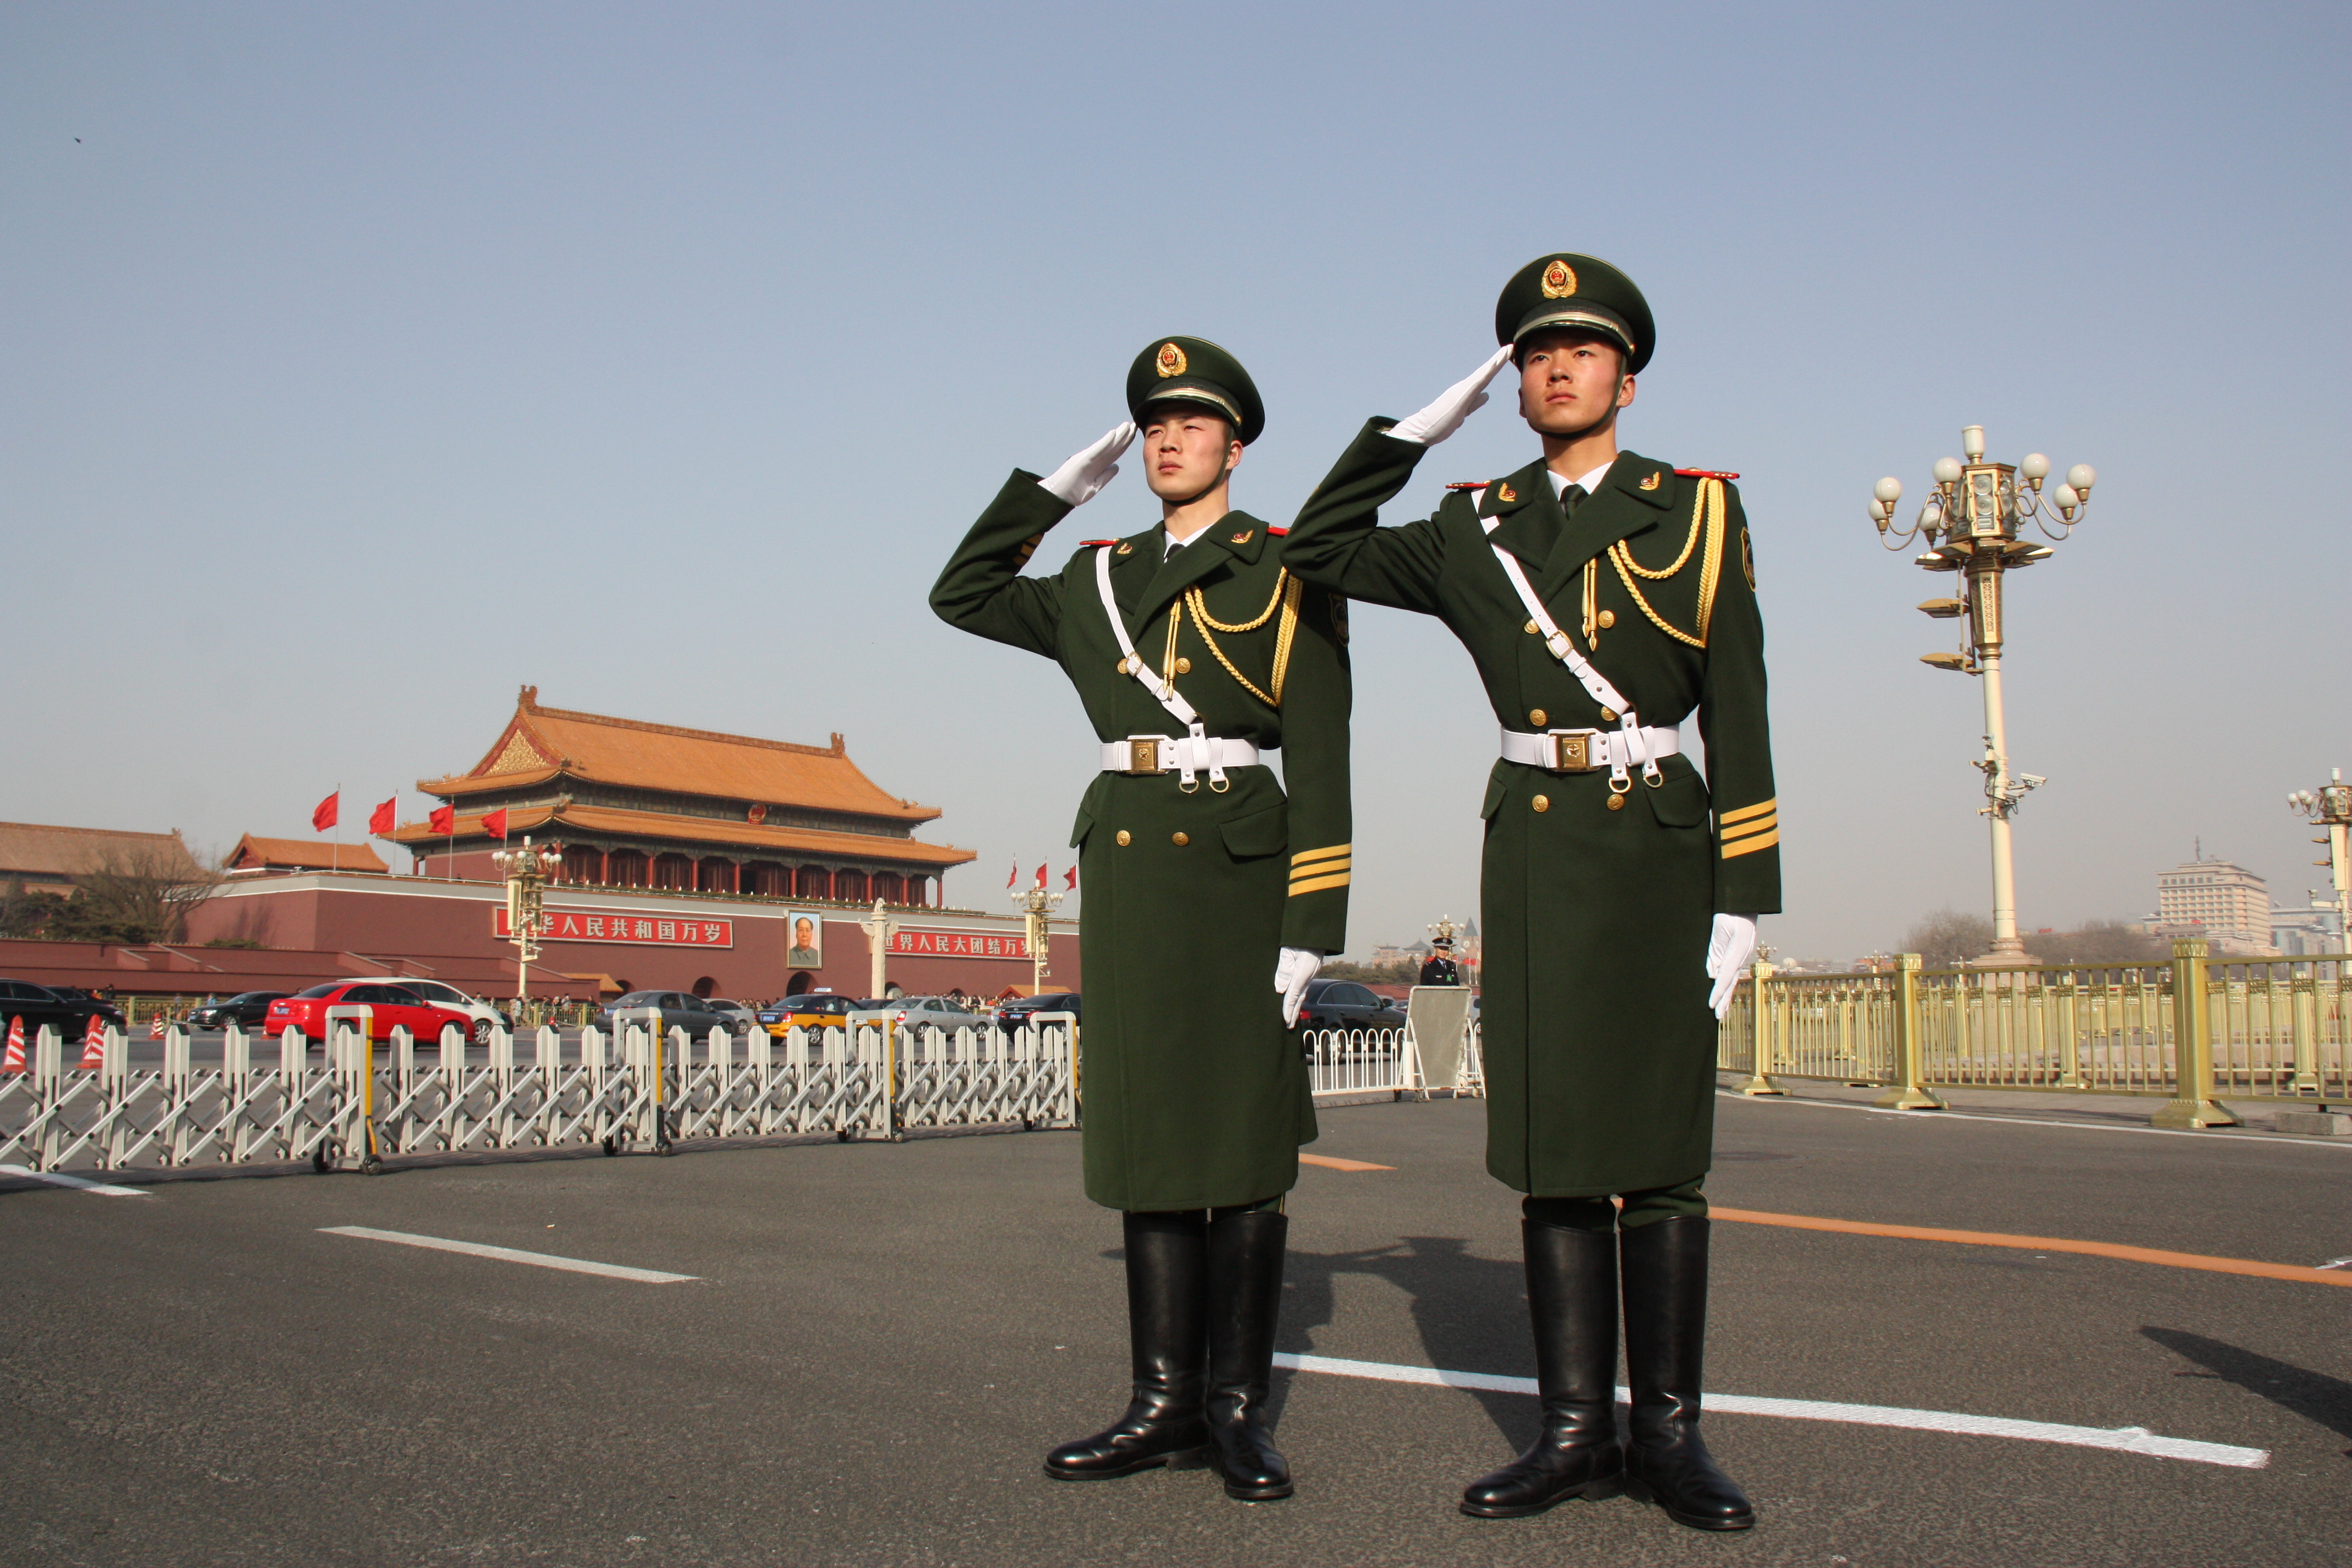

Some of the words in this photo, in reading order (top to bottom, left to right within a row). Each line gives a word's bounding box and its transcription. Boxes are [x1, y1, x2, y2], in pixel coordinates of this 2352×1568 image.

[541, 914, 721, 942] 华人民共和国万岁
